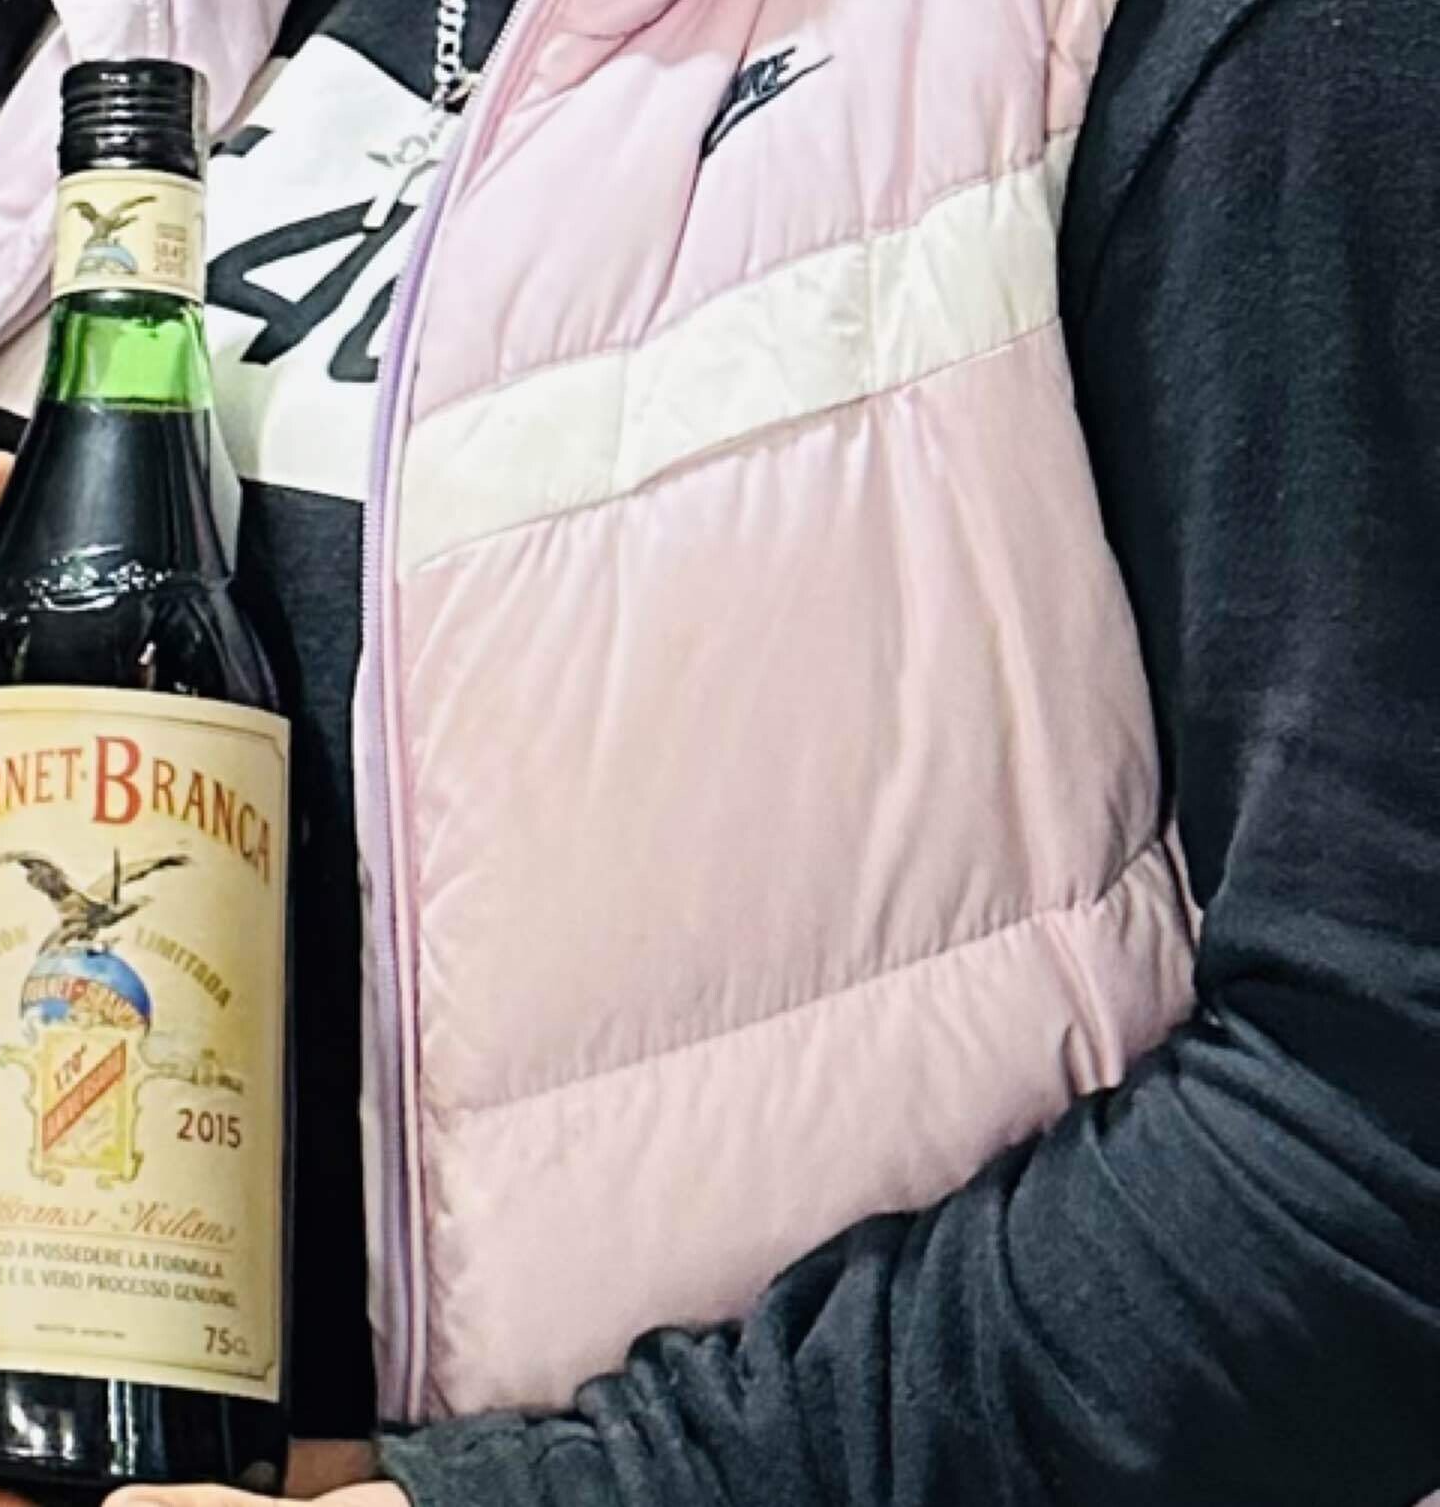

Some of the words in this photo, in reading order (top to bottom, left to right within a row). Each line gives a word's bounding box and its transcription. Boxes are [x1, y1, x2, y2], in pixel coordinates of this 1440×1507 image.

[91, 734, 272, 887] BRANCA
[134, 924, 232, 1009] LIMITADA
[176, 1107, 243, 1150] 2015
